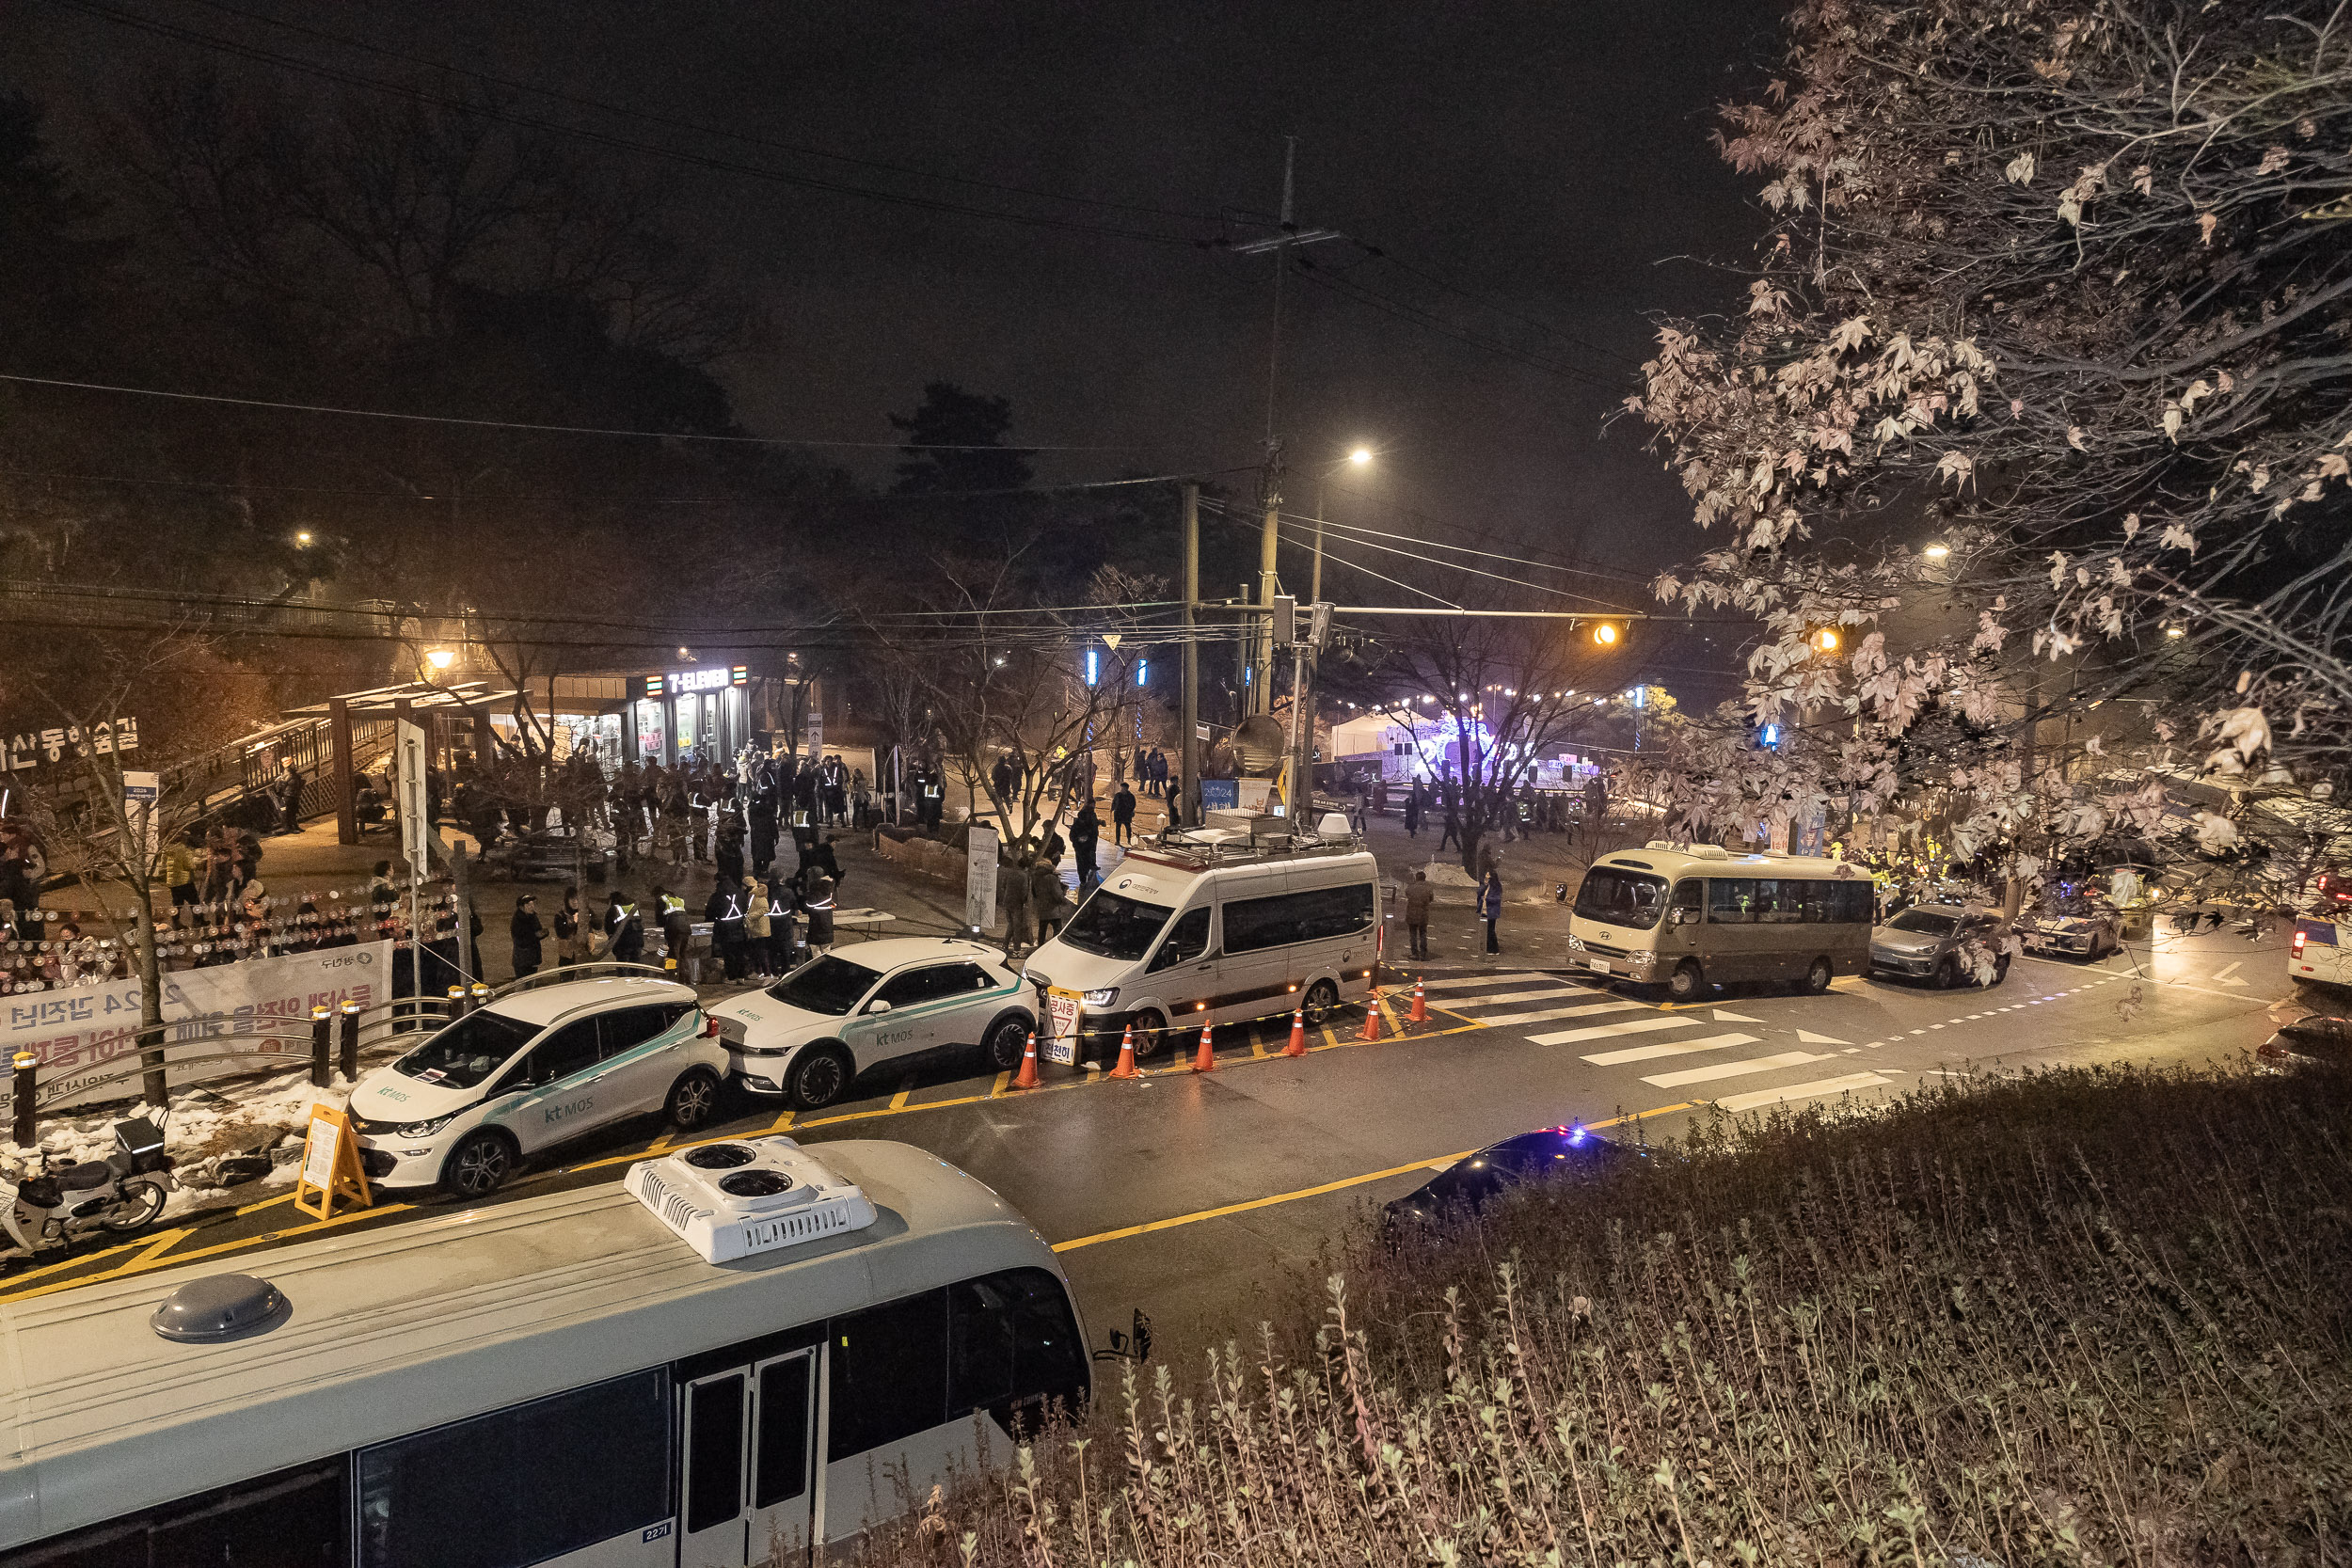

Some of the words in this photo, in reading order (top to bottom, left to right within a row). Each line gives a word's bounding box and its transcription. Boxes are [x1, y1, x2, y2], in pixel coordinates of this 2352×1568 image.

[1050, 999, 1074, 1016] 공사중
[876, 1033, 890, 1047] kt
[892, 1030, 914, 1044] MOS
[1045, 1042, 1070, 1059] 천천히
[377, 1085, 391, 1096] kt
[389, 1090, 412, 1102] MOS
[544, 1105, 563, 1124] kt
[564, 1096, 595, 1117] MOS
[646, 1524, 668, 1541] 2271
